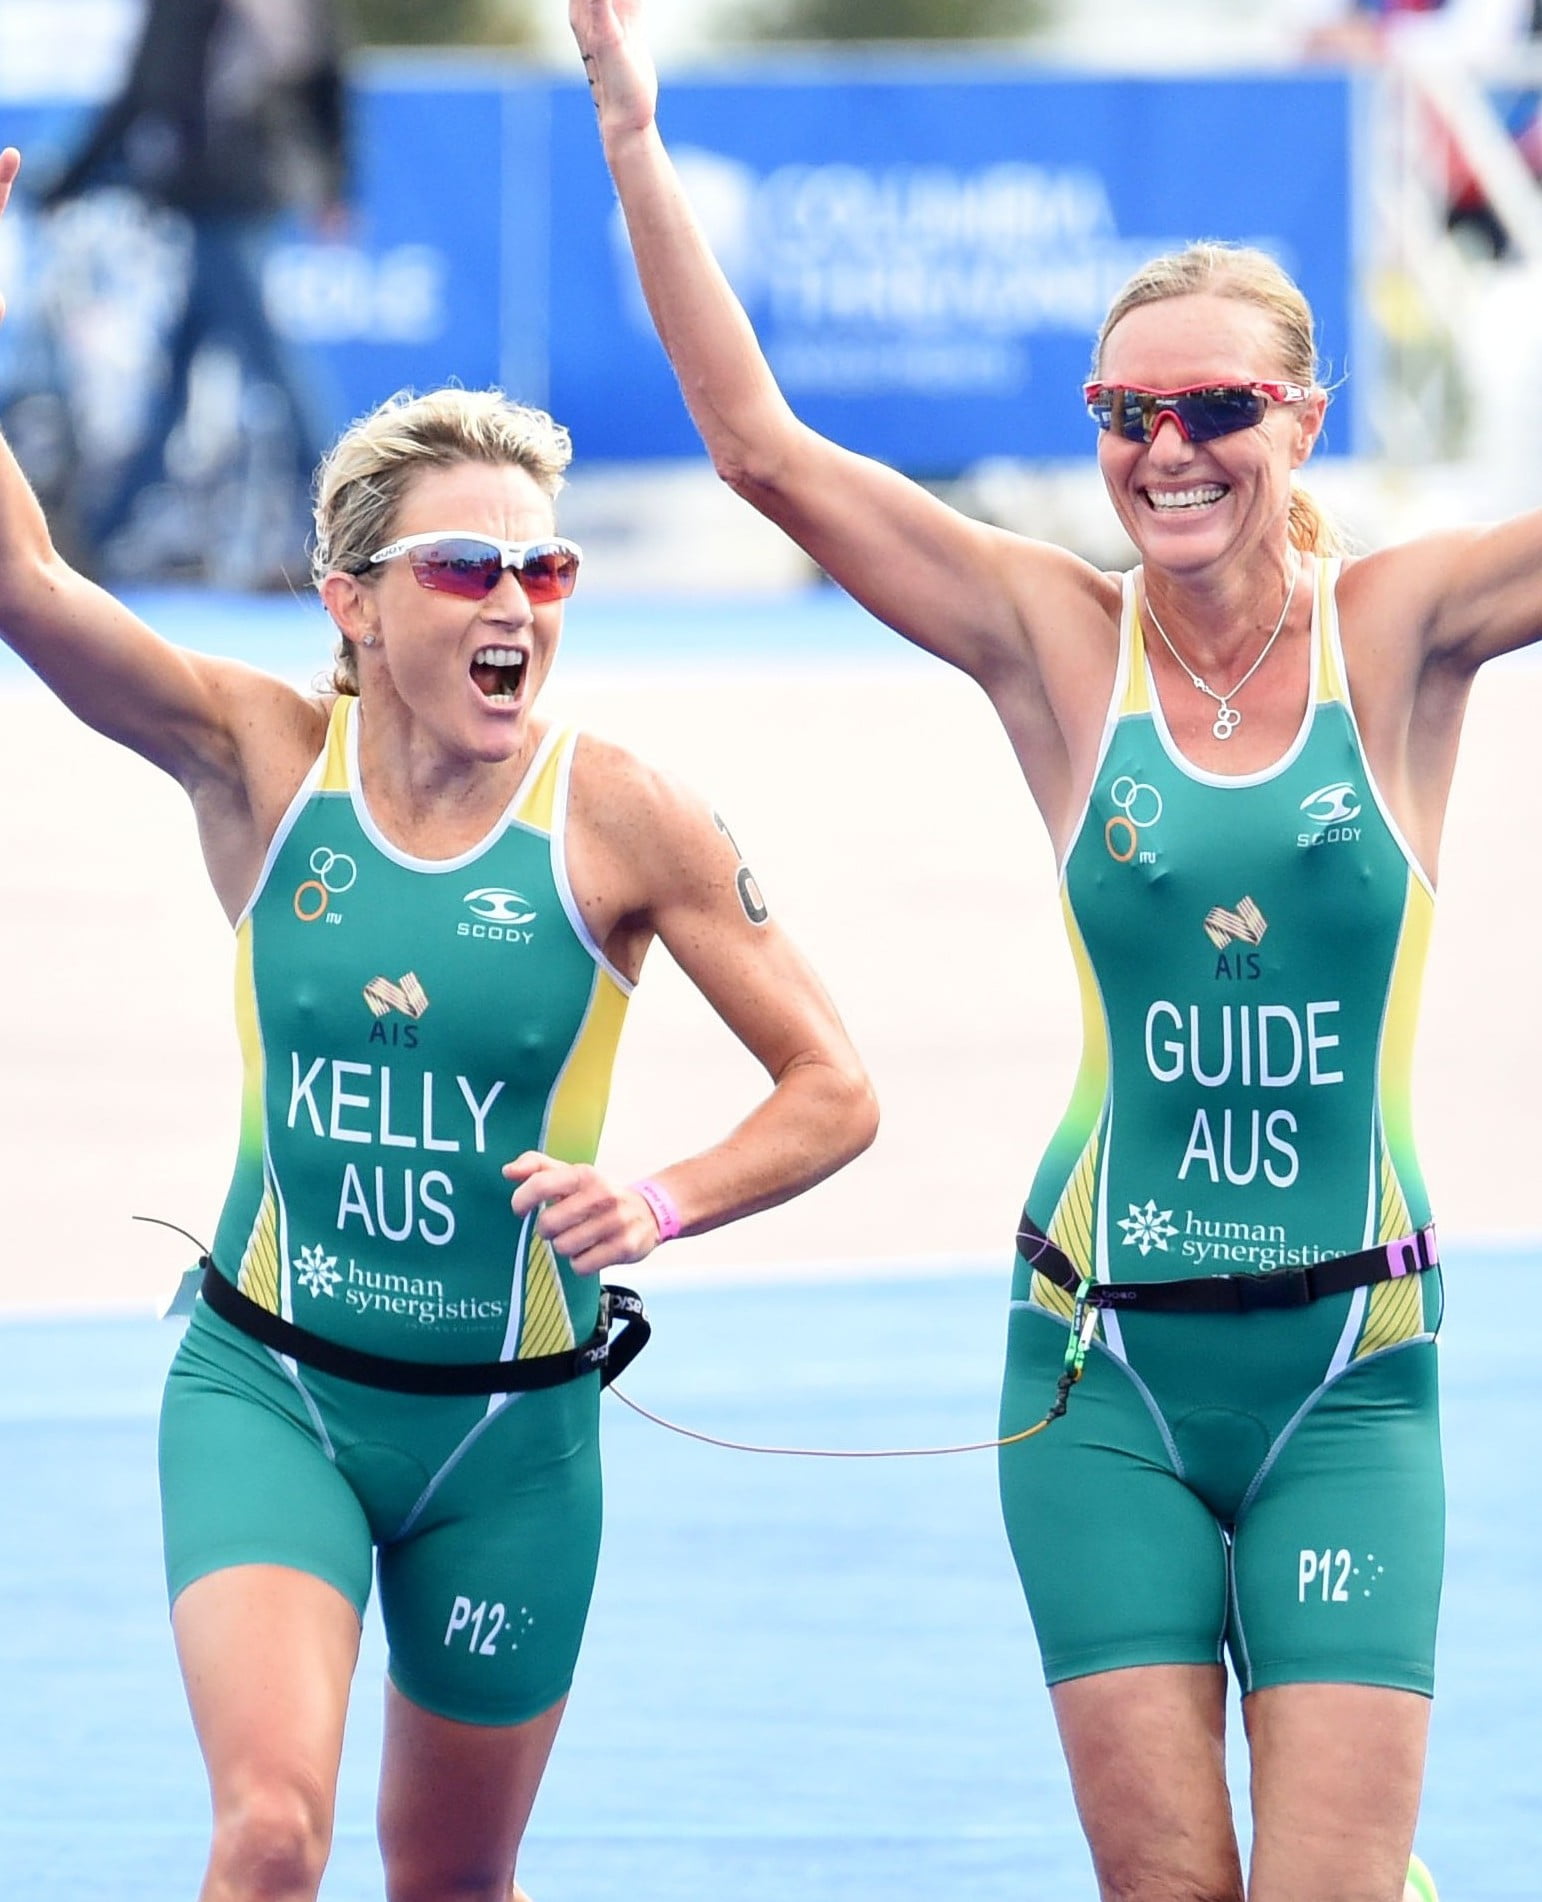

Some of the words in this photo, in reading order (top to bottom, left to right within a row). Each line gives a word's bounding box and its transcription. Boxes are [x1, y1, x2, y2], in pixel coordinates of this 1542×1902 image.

[1297, 828, 1361, 847] SCODY
[1139, 851, 1156, 863] ITU
[326, 912, 342, 924] ITU
[457, 922, 533, 944] SCODY
[1215, 953, 1261, 980] AIS
[368, 1021, 418, 1048] AIS
[1145, 1000, 1344, 1087] GUIDE
[287, 1051, 505, 1152] KELLY
[1177, 1108, 1299, 1188] AUS
[337, 1163, 455, 1246] AUS
[1185, 1210, 1285, 1242] human
[349, 1259, 443, 1296] human
[346, 1287, 502, 1324] synergistics
[1298, 1548, 1352, 1603] P12
[444, 1595, 505, 1656] P12
